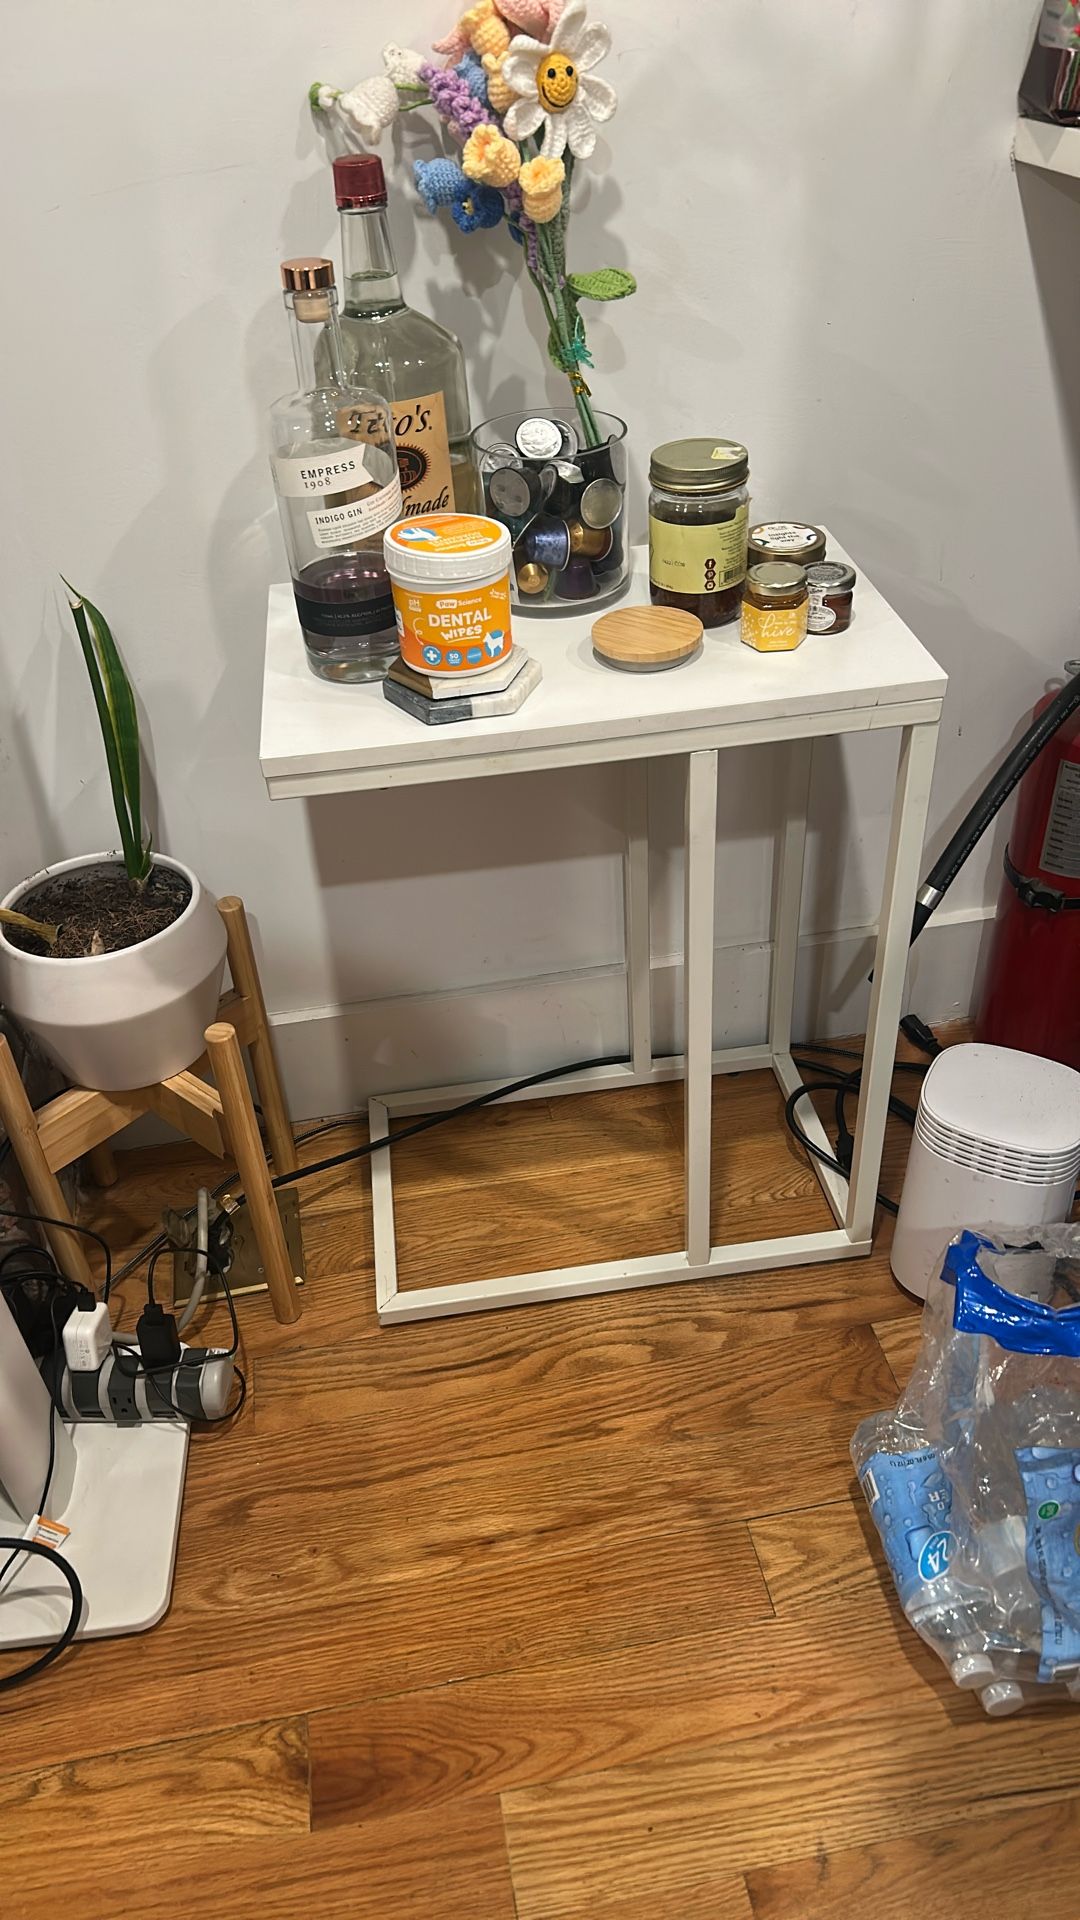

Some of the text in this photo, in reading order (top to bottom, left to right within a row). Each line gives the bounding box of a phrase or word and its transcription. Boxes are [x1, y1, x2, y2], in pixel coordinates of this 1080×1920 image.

[300, 460, 356, 480] EMPRESS
[304, 477, 332, 490] 1908
[315, 507, 363, 525] INDIGO GIN
[439, 597, 483, 608] Paw Science
[427, 607, 492, 627] DENTAL
[758, 613, 796, 638] hive
[440, 624, 483, 641] WIPES
